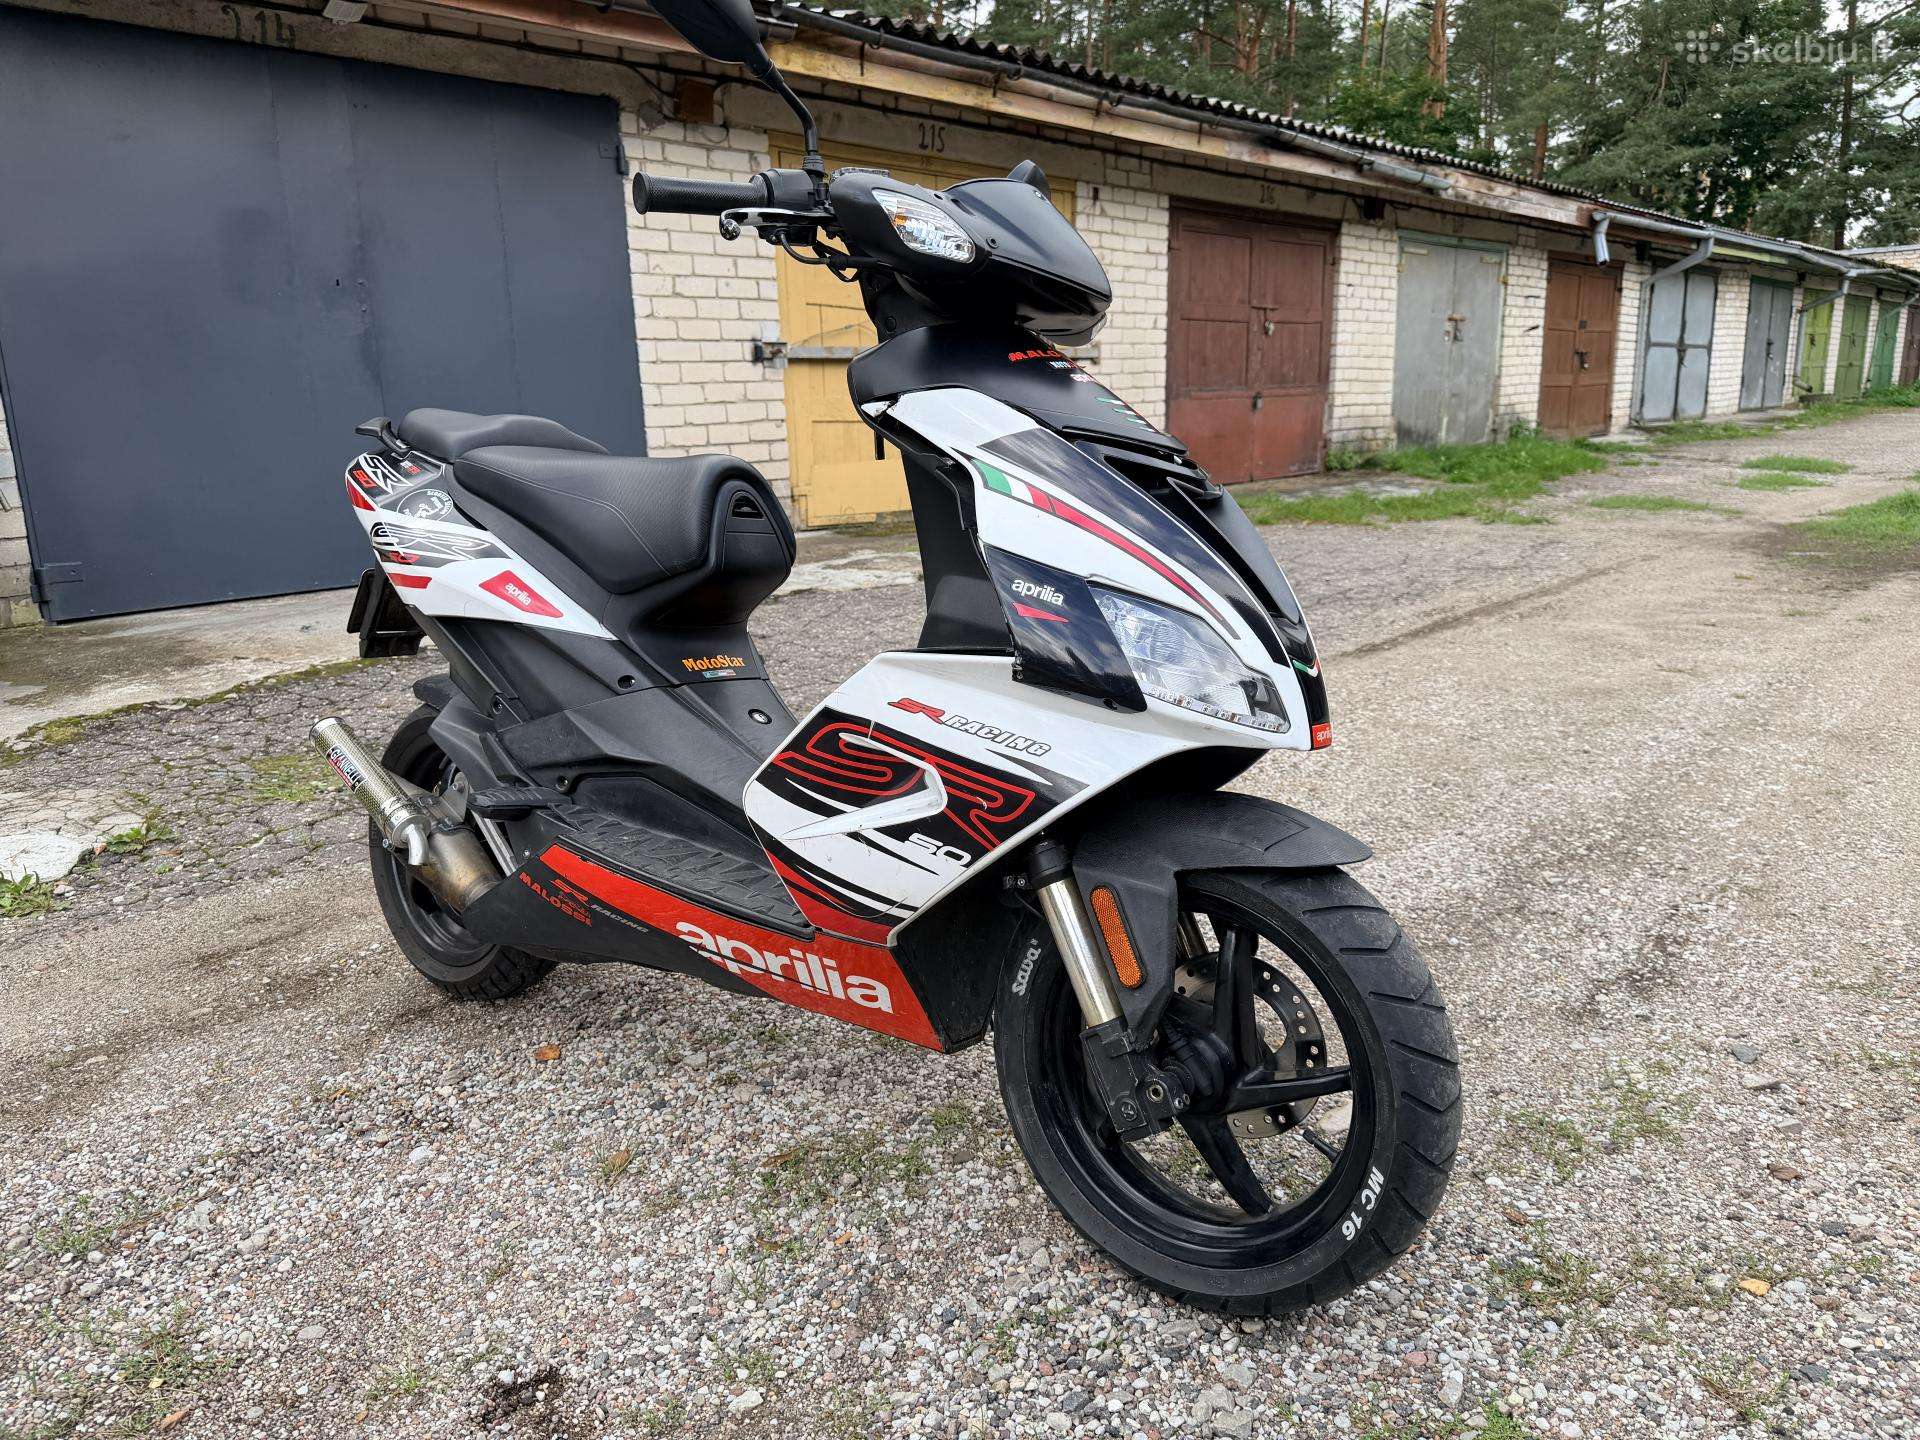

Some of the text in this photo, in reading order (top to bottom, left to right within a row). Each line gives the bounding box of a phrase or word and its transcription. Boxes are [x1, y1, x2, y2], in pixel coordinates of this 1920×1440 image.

[918, 122, 946, 153] 215
[505, 582, 532, 606] aprilia
[1011, 579, 1064, 606] aprilia
[682, 655, 746, 672] MotoStar
[887, 697, 1052, 757] SR RACING
[772, 722, 1036, 852] SR
[905, 832, 972, 868] 50
[519, 871, 593, 928] MALOSSI
[590, 904, 649, 932] RACING
[675, 921, 895, 1014] aprilia
[1341, 1166, 1385, 1241] MC 16
